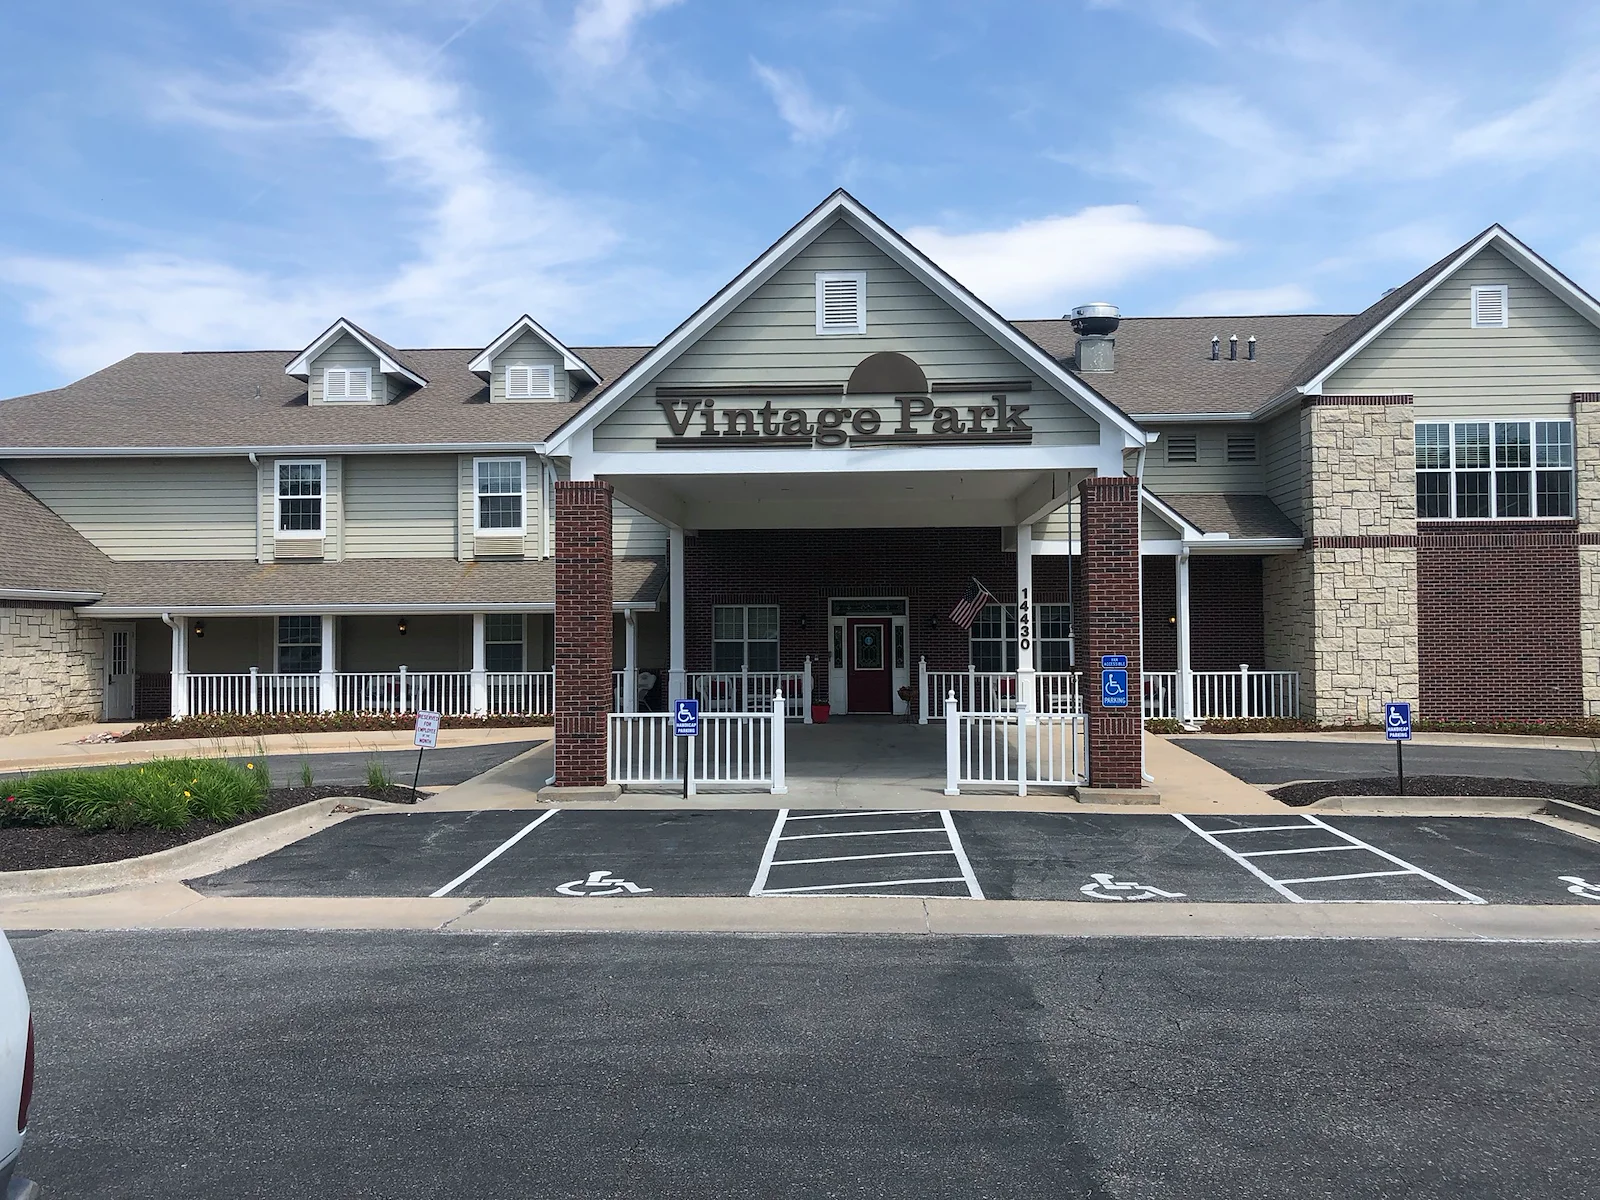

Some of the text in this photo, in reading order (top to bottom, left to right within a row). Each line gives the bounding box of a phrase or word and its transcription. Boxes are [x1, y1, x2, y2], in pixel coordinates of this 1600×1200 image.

[656, 394, 1033, 446] Vintage Park
[1020, 587, 1030, 650] 14430
[417, 713, 439, 721] RESERVED
